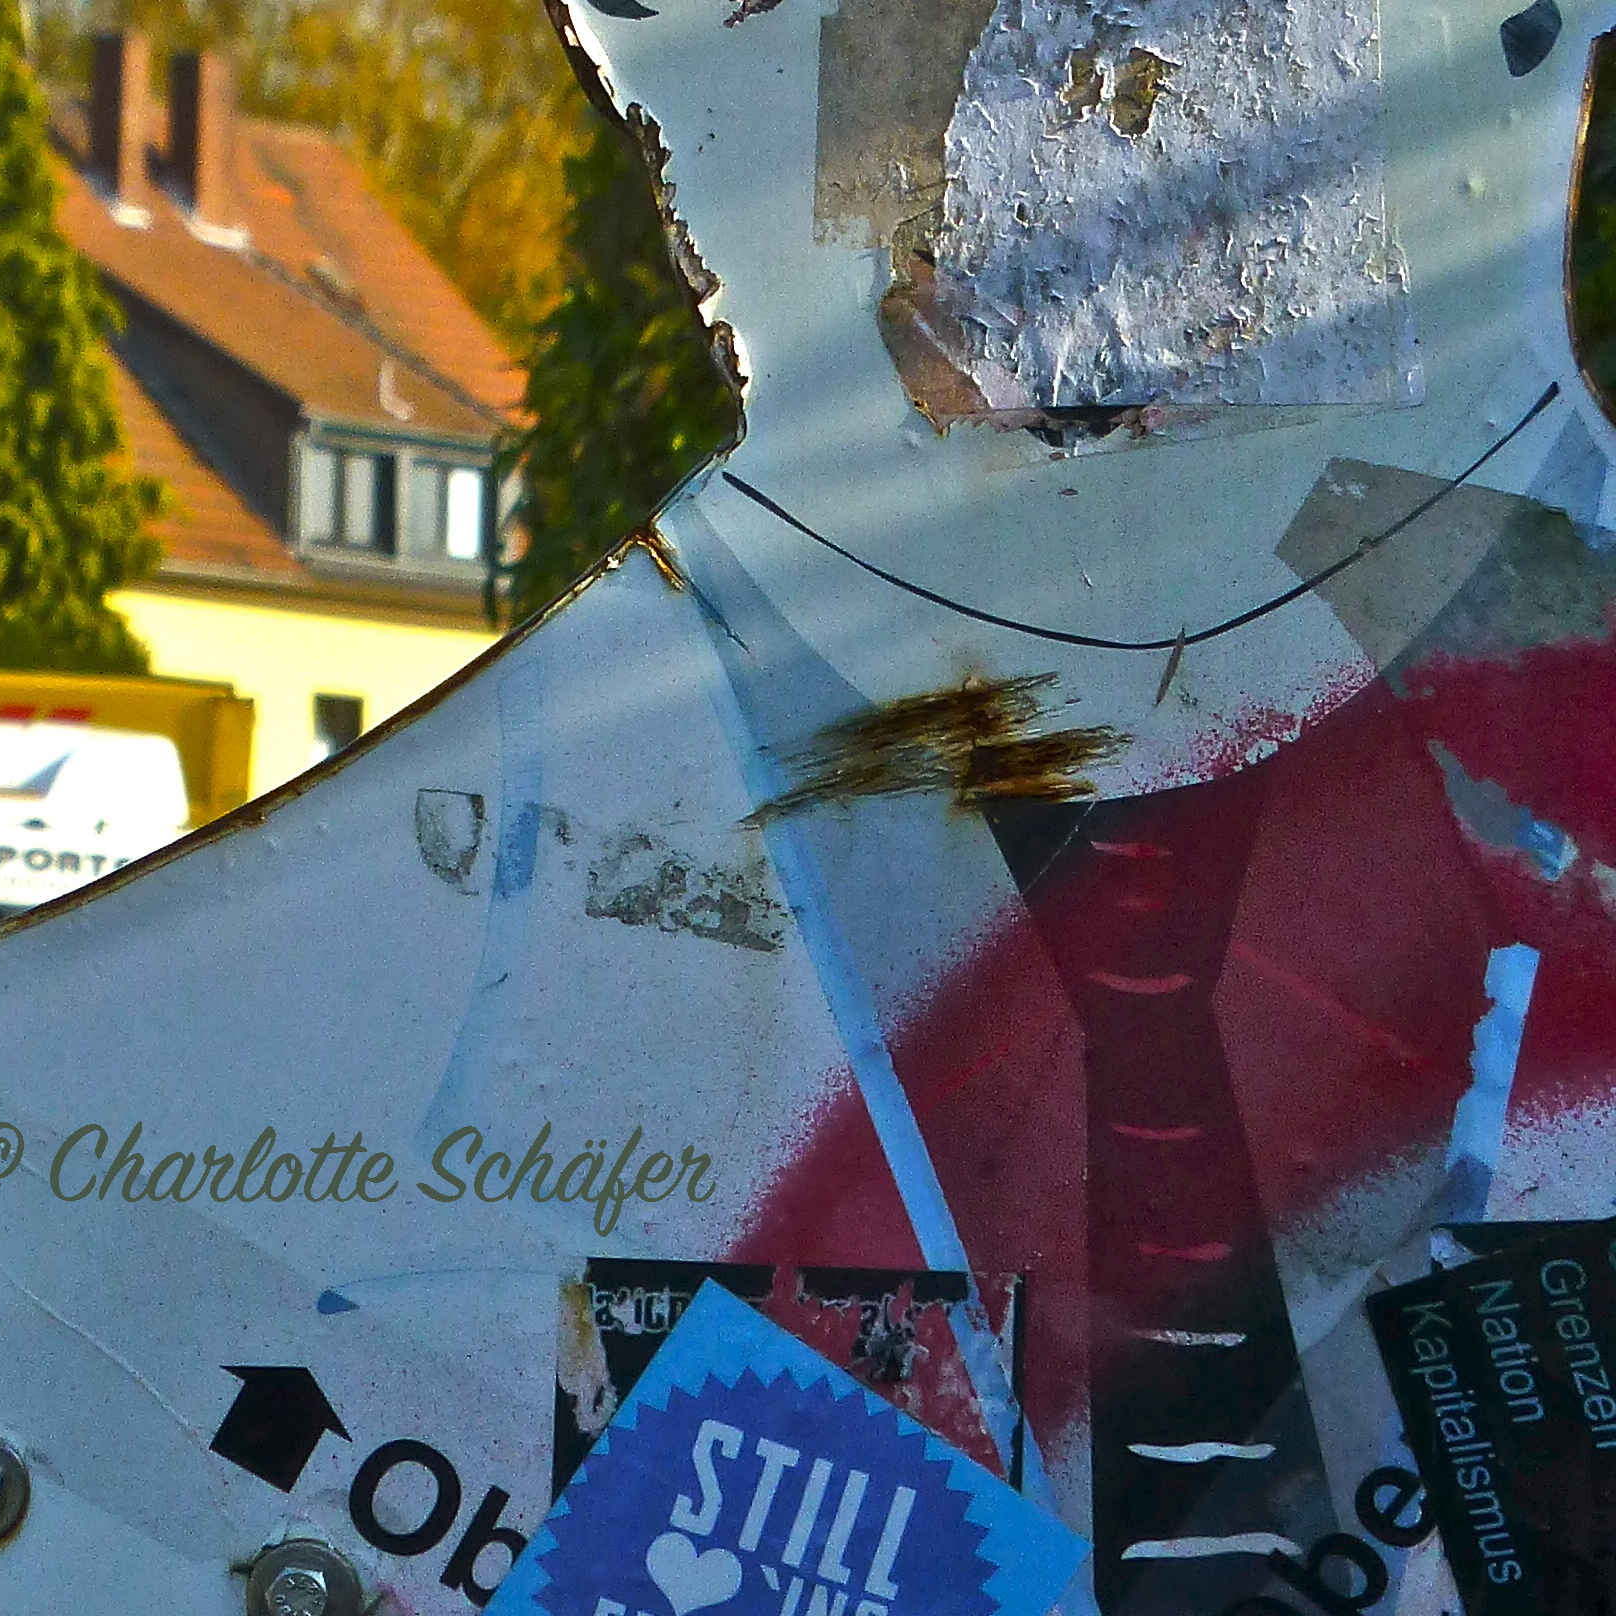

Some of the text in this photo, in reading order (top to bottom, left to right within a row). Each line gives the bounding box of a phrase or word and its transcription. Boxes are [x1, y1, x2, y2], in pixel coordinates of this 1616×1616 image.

[1469, 1279, 1545, 1423] Nation
[349, 1439, 529, 1607] Ob
[670, 1419, 917, 1601] STILL
[1401, 1300, 1522, 1584] Kapitalismus
